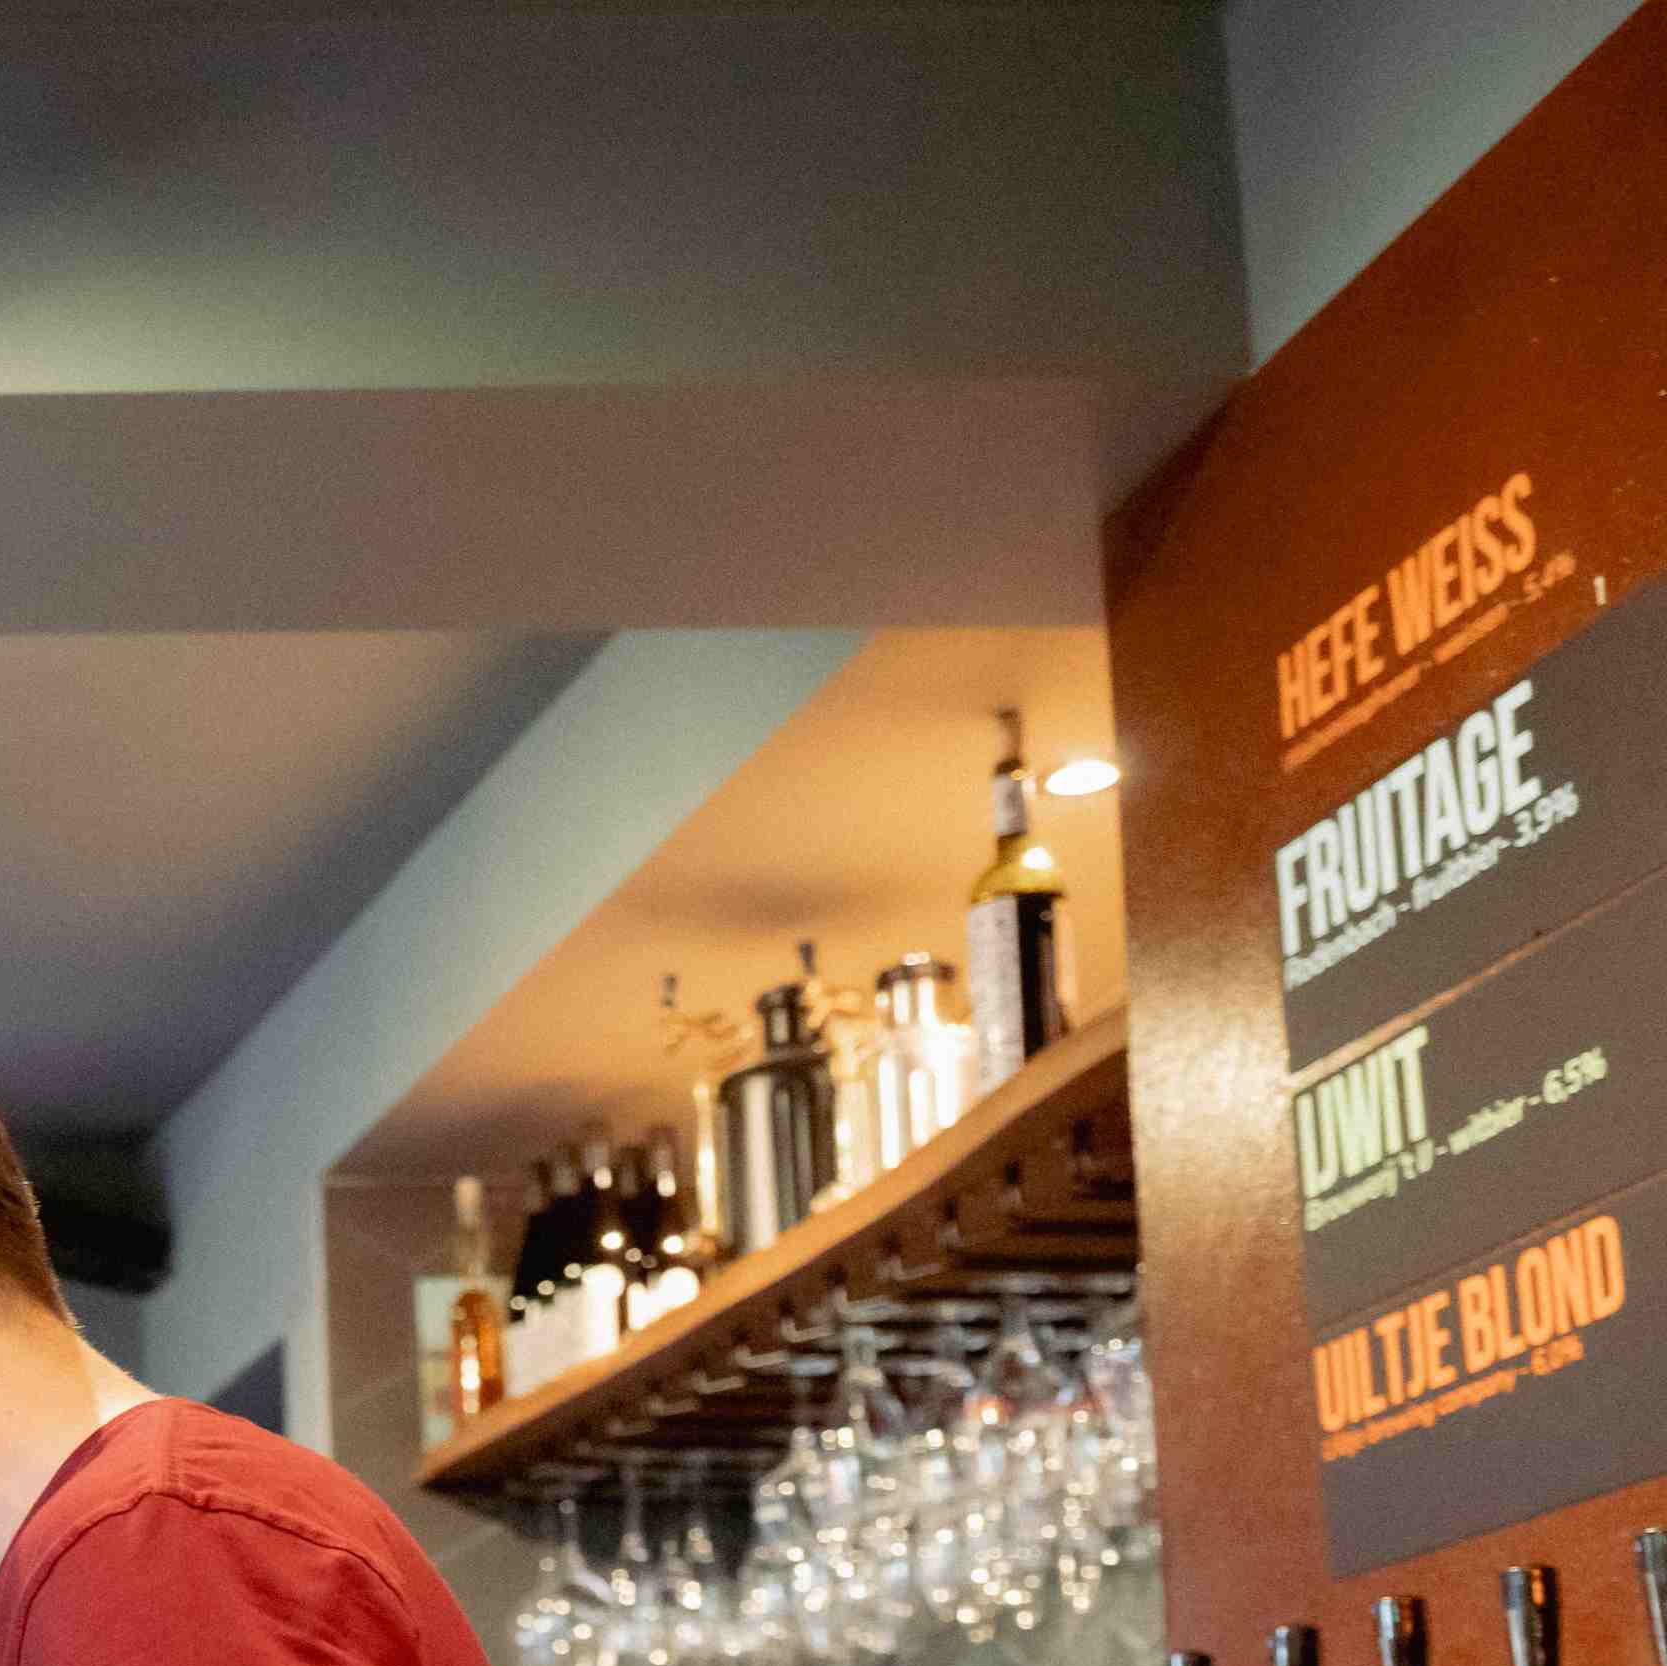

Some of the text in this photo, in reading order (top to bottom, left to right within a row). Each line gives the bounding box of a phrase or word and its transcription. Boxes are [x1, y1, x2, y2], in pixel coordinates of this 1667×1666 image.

[1278, 584, 1385, 738] HEFE
[1387, 473, 1537, 657] WEISS
[1276, 679, 1541, 957] FRUITAGE
[1311, 1214, 1626, 1434] UILTJE BLOND
